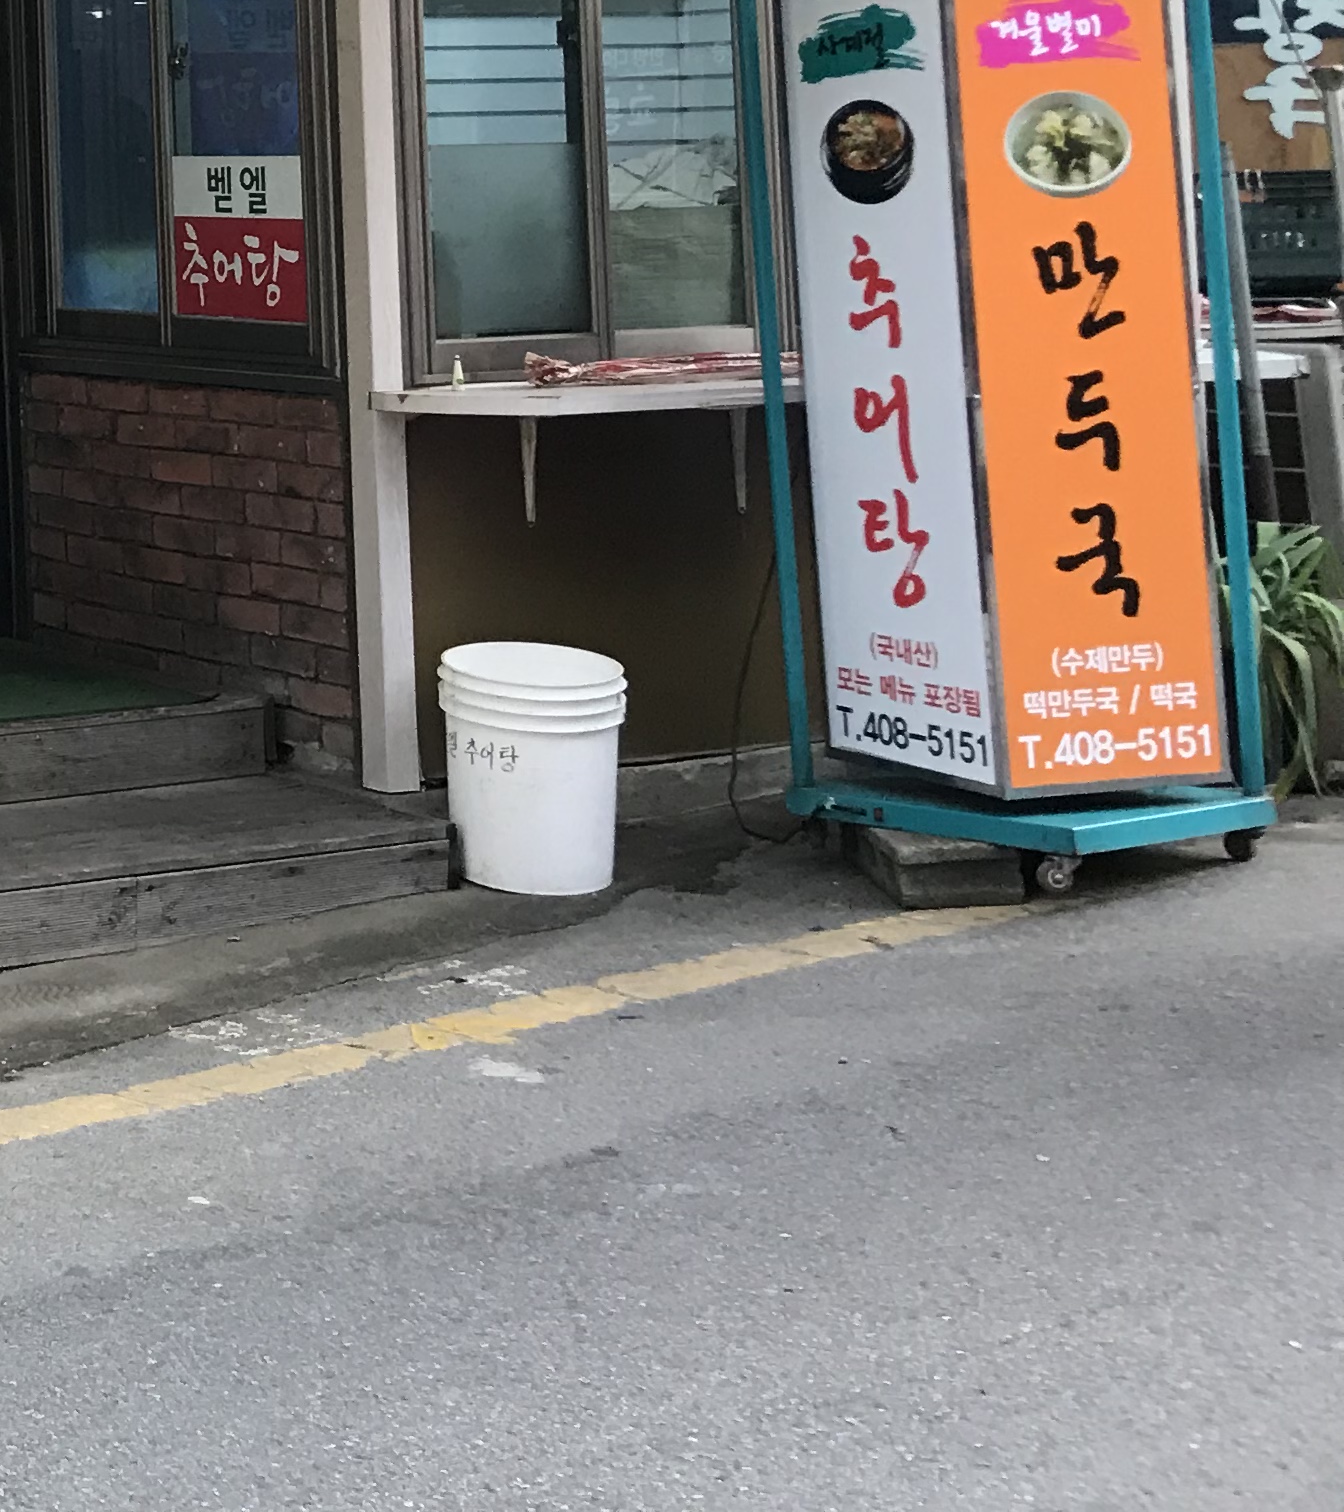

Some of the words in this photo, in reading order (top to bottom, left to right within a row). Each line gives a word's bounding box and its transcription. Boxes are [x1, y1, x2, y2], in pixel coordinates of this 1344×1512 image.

[990, 9, 1102, 57] 겨울별미
[181, 221, 300, 308] 추어탕
[847, 233, 931, 610] 추어탕
[1032, 220, 1141, 620] 만두국
[869, 631, 939, 670] (국내산)
[1051, 642, 1164, 678] (수제만두)
[836, 666, 873, 697] 모든
[879, 675, 916, 705] 메뉴
[923, 682, 983, 719] 포장됨
[1022, 684, 1120, 720] 떡만두국
[1150, 680, 1198, 711] 떡국
[464, 737, 520, 773] 추어탕
[835, 704, 990, 768] T.408-5151
[1018, 722, 1213, 771] T.408-5151
